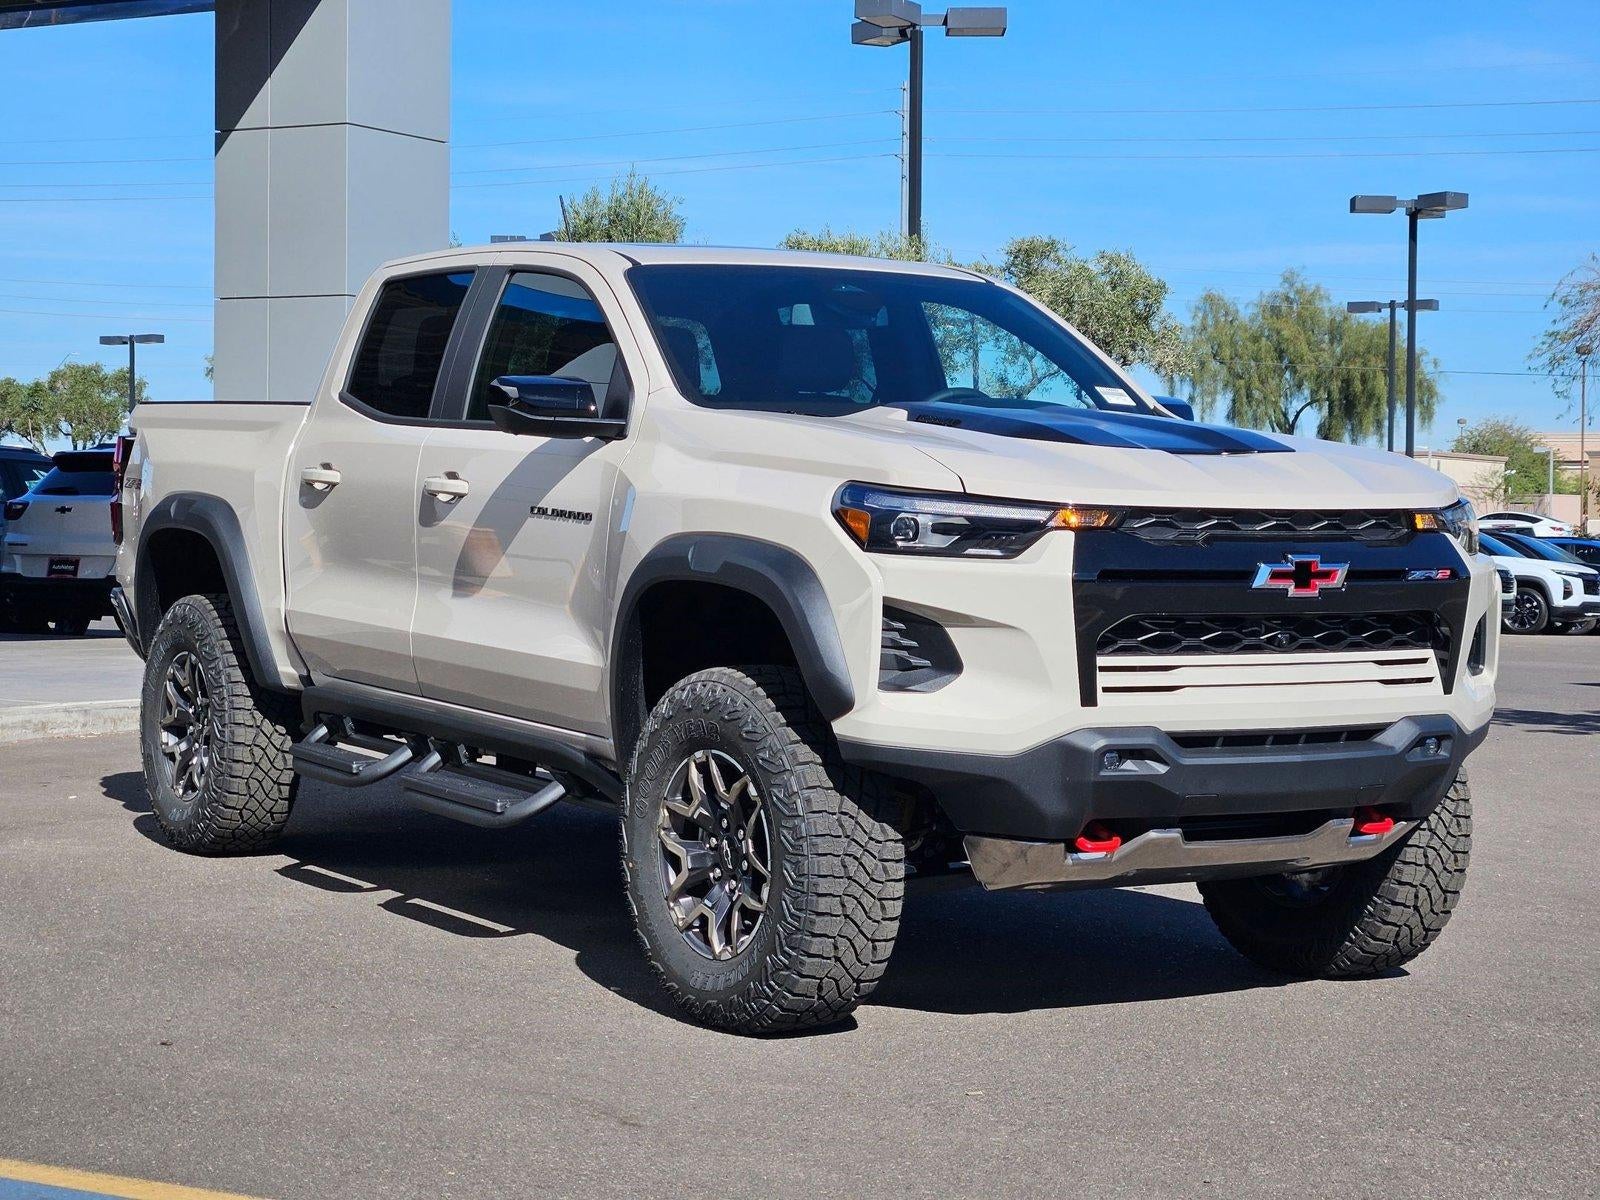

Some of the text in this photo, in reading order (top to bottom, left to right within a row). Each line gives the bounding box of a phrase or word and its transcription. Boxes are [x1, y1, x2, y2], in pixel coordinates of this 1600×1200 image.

[530, 506, 593, 522] COLORADO
[1408, 569, 1451, 580] ZR2
[634, 718, 721, 819] GOODYEAR
